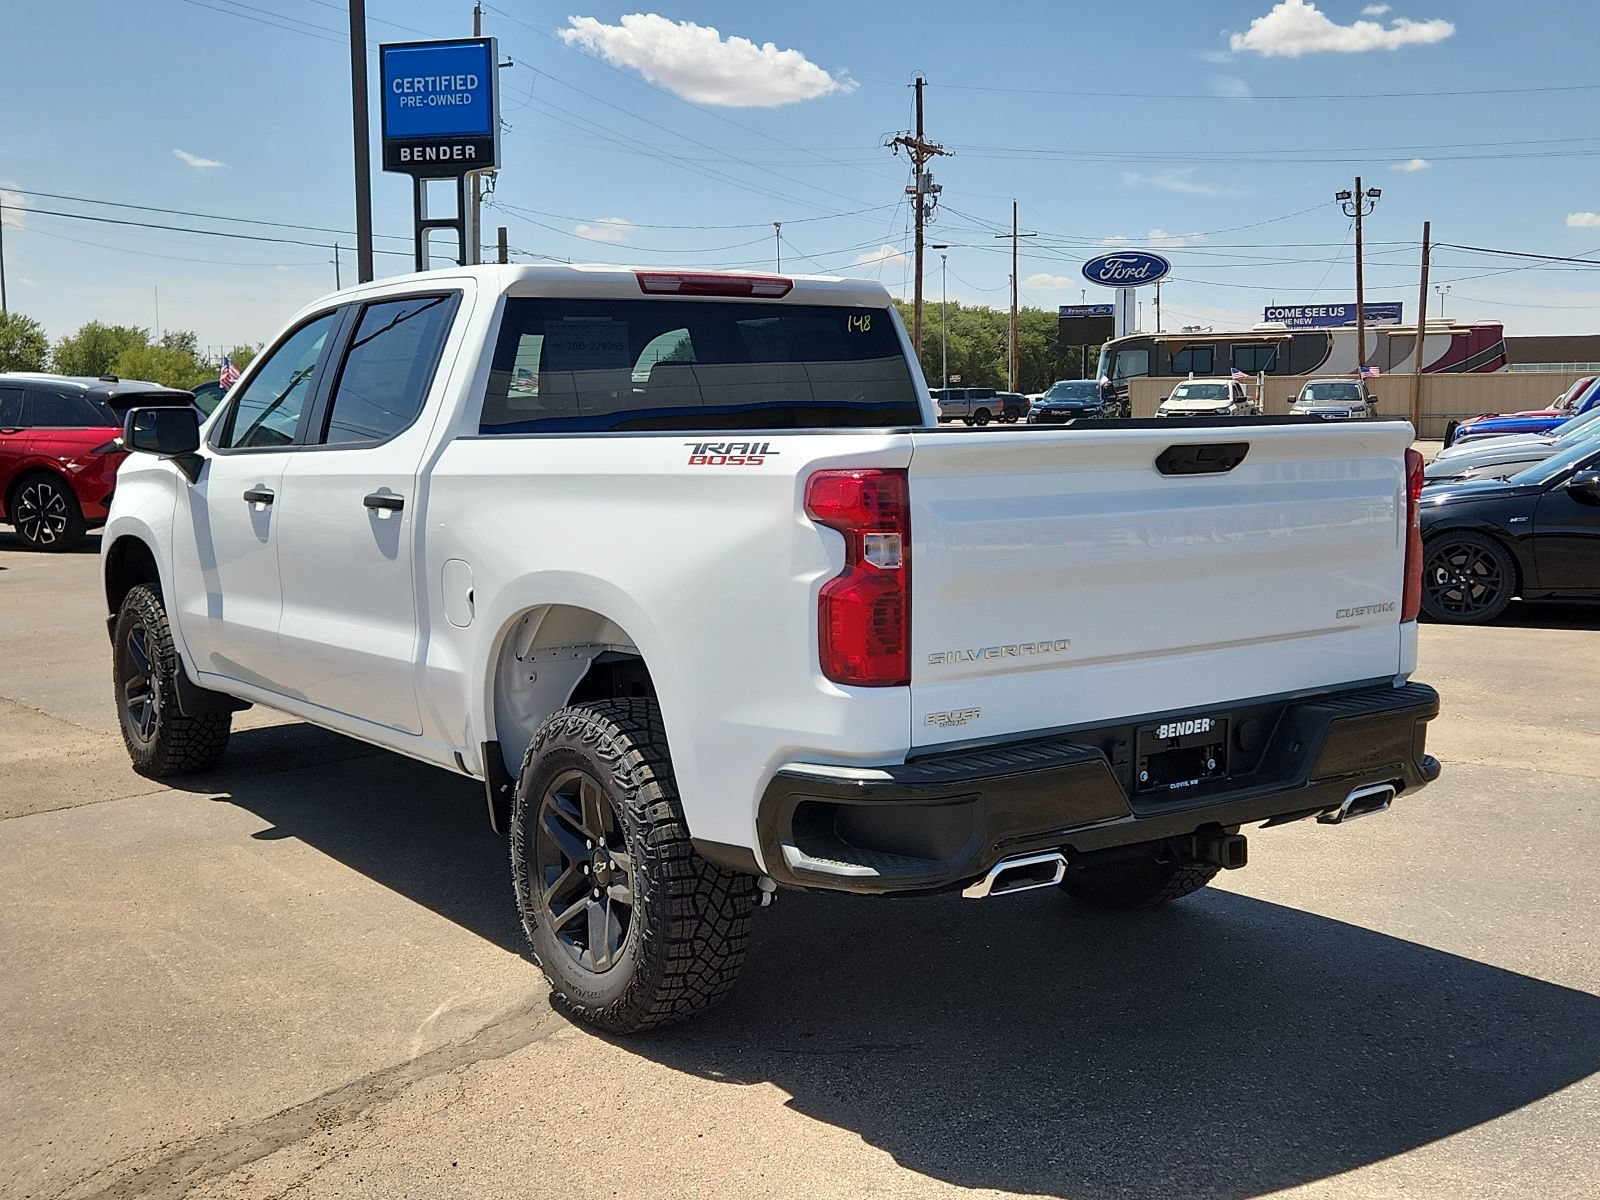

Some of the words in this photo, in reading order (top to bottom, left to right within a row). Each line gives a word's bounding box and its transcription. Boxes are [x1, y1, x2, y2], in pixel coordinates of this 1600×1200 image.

[392, 74, 479, 94] CERTIFIED
[400, 93, 472, 108] PRE-OWNED
[400, 145, 476, 162] BENDER
[1099, 258, 1151, 280] Ford
[1266, 308, 1303, 319] COME
[1304, 307, 1327, 318] SEE
[1328, 306, 1345, 317] US
[1293, 317, 1313, 325] NEW
[847, 314, 871, 333] 148
[684, 442, 781, 455] TRAIL
[687, 455, 766, 466] BOSS
[1335, 601, 1395, 619] CUSTOM
[928, 639, 1072, 666] SILVERADO
[1158, 718, 1210, 739] BENDER
